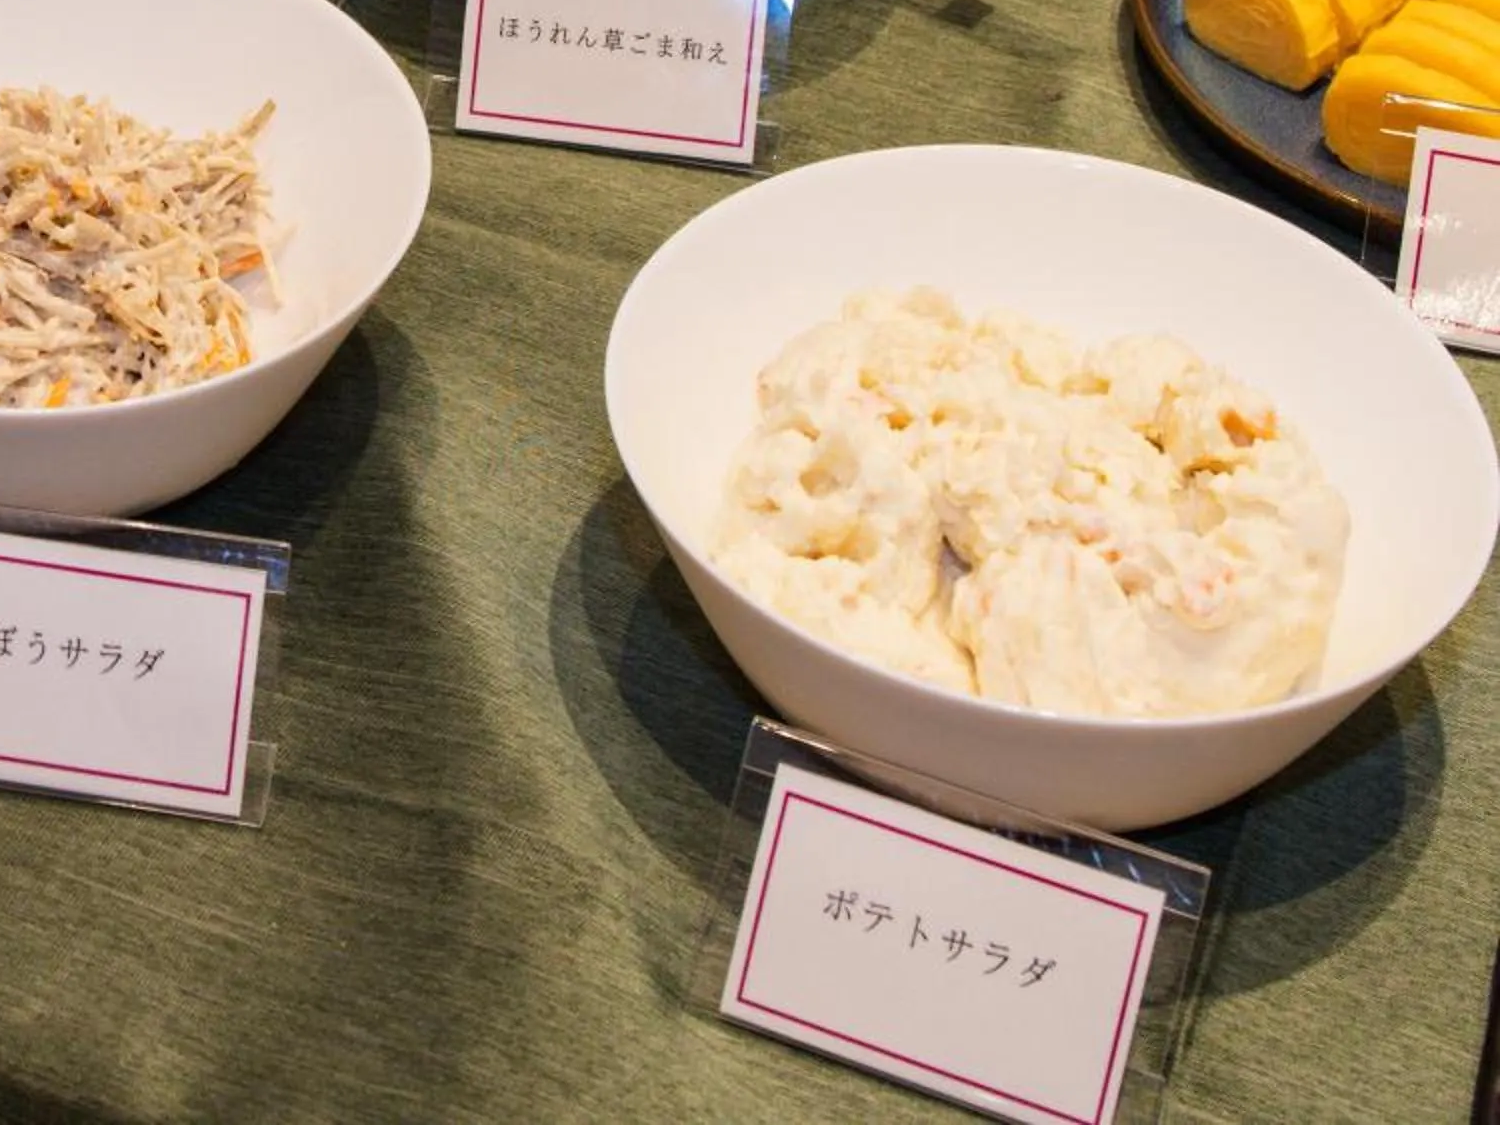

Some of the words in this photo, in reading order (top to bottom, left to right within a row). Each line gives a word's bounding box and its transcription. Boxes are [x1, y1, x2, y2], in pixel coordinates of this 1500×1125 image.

[499, 16, 728, 65] ほうれん草ごま和え
[822, 889, 1058, 988] ポテトサラダ
